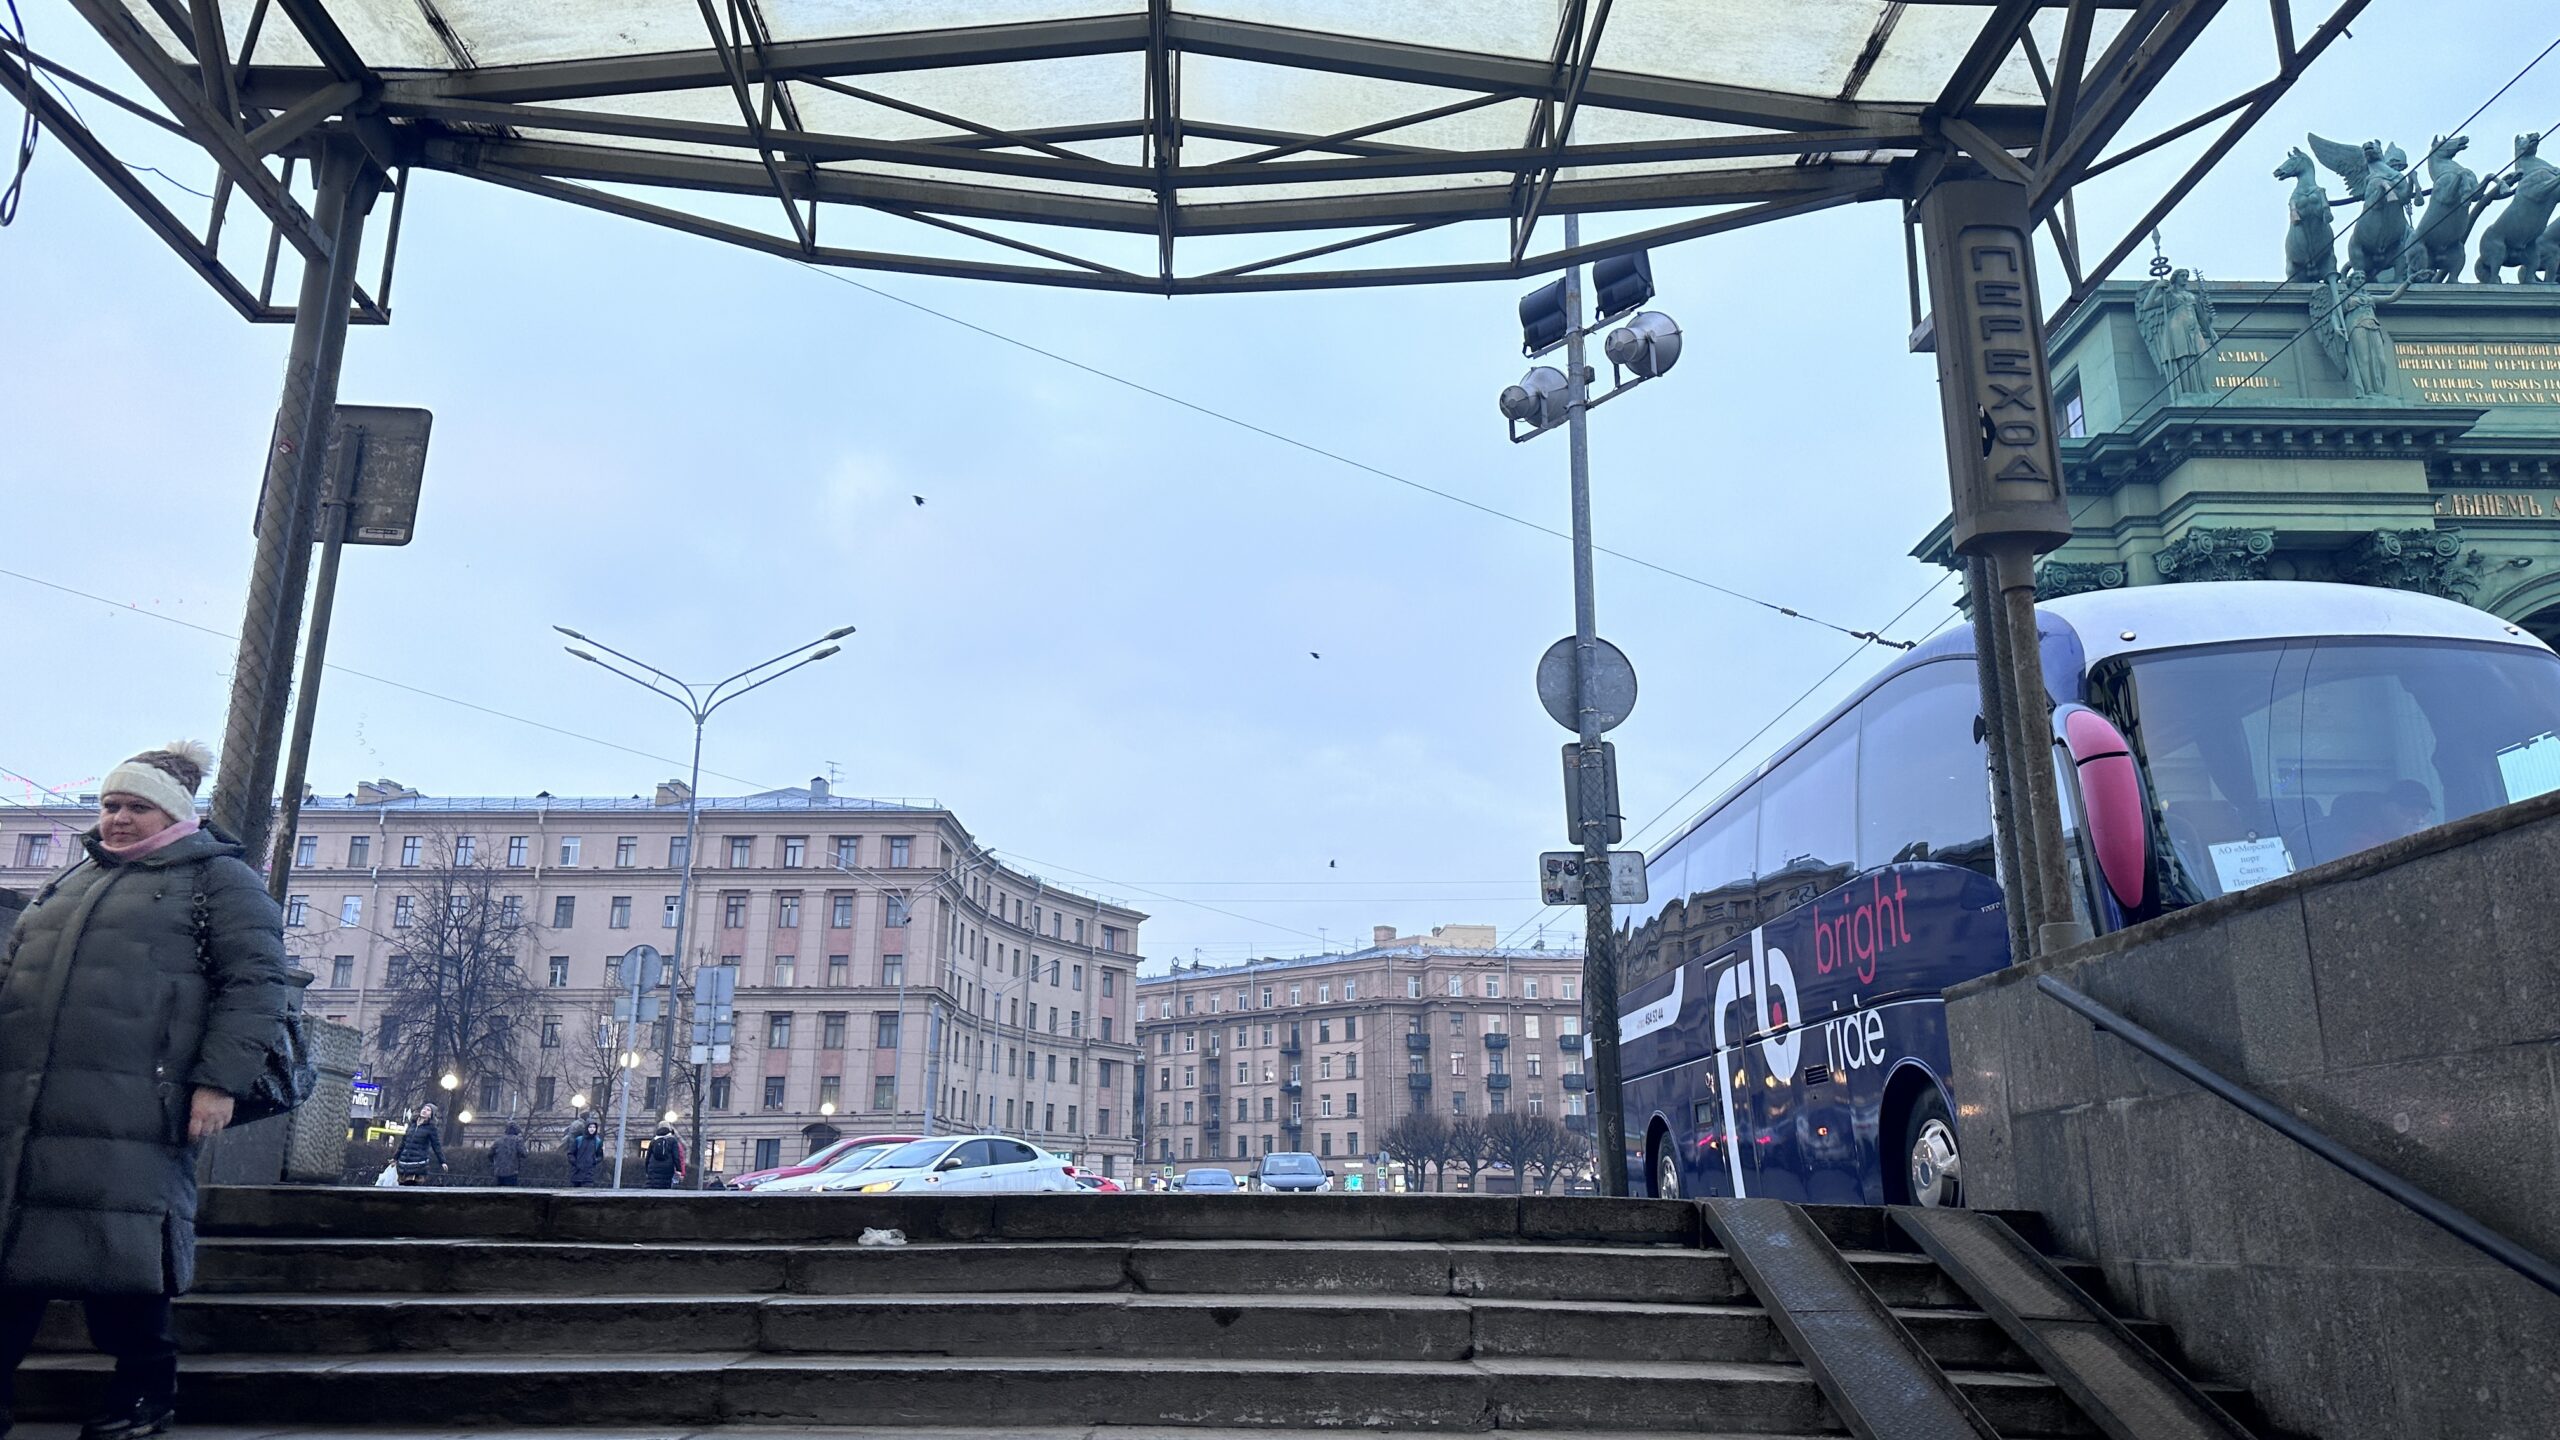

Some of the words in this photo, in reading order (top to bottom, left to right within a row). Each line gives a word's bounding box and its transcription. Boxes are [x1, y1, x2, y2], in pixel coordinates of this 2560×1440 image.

[1970, 245, 2049, 482] ПЕРЕХОД
[2490, 379, 2541, 390] ROSSICIS
[2218, 846, 2232, 855] АО
[1813, 874, 1911, 985] bright
[1825, 993, 1886, 1073] ride
